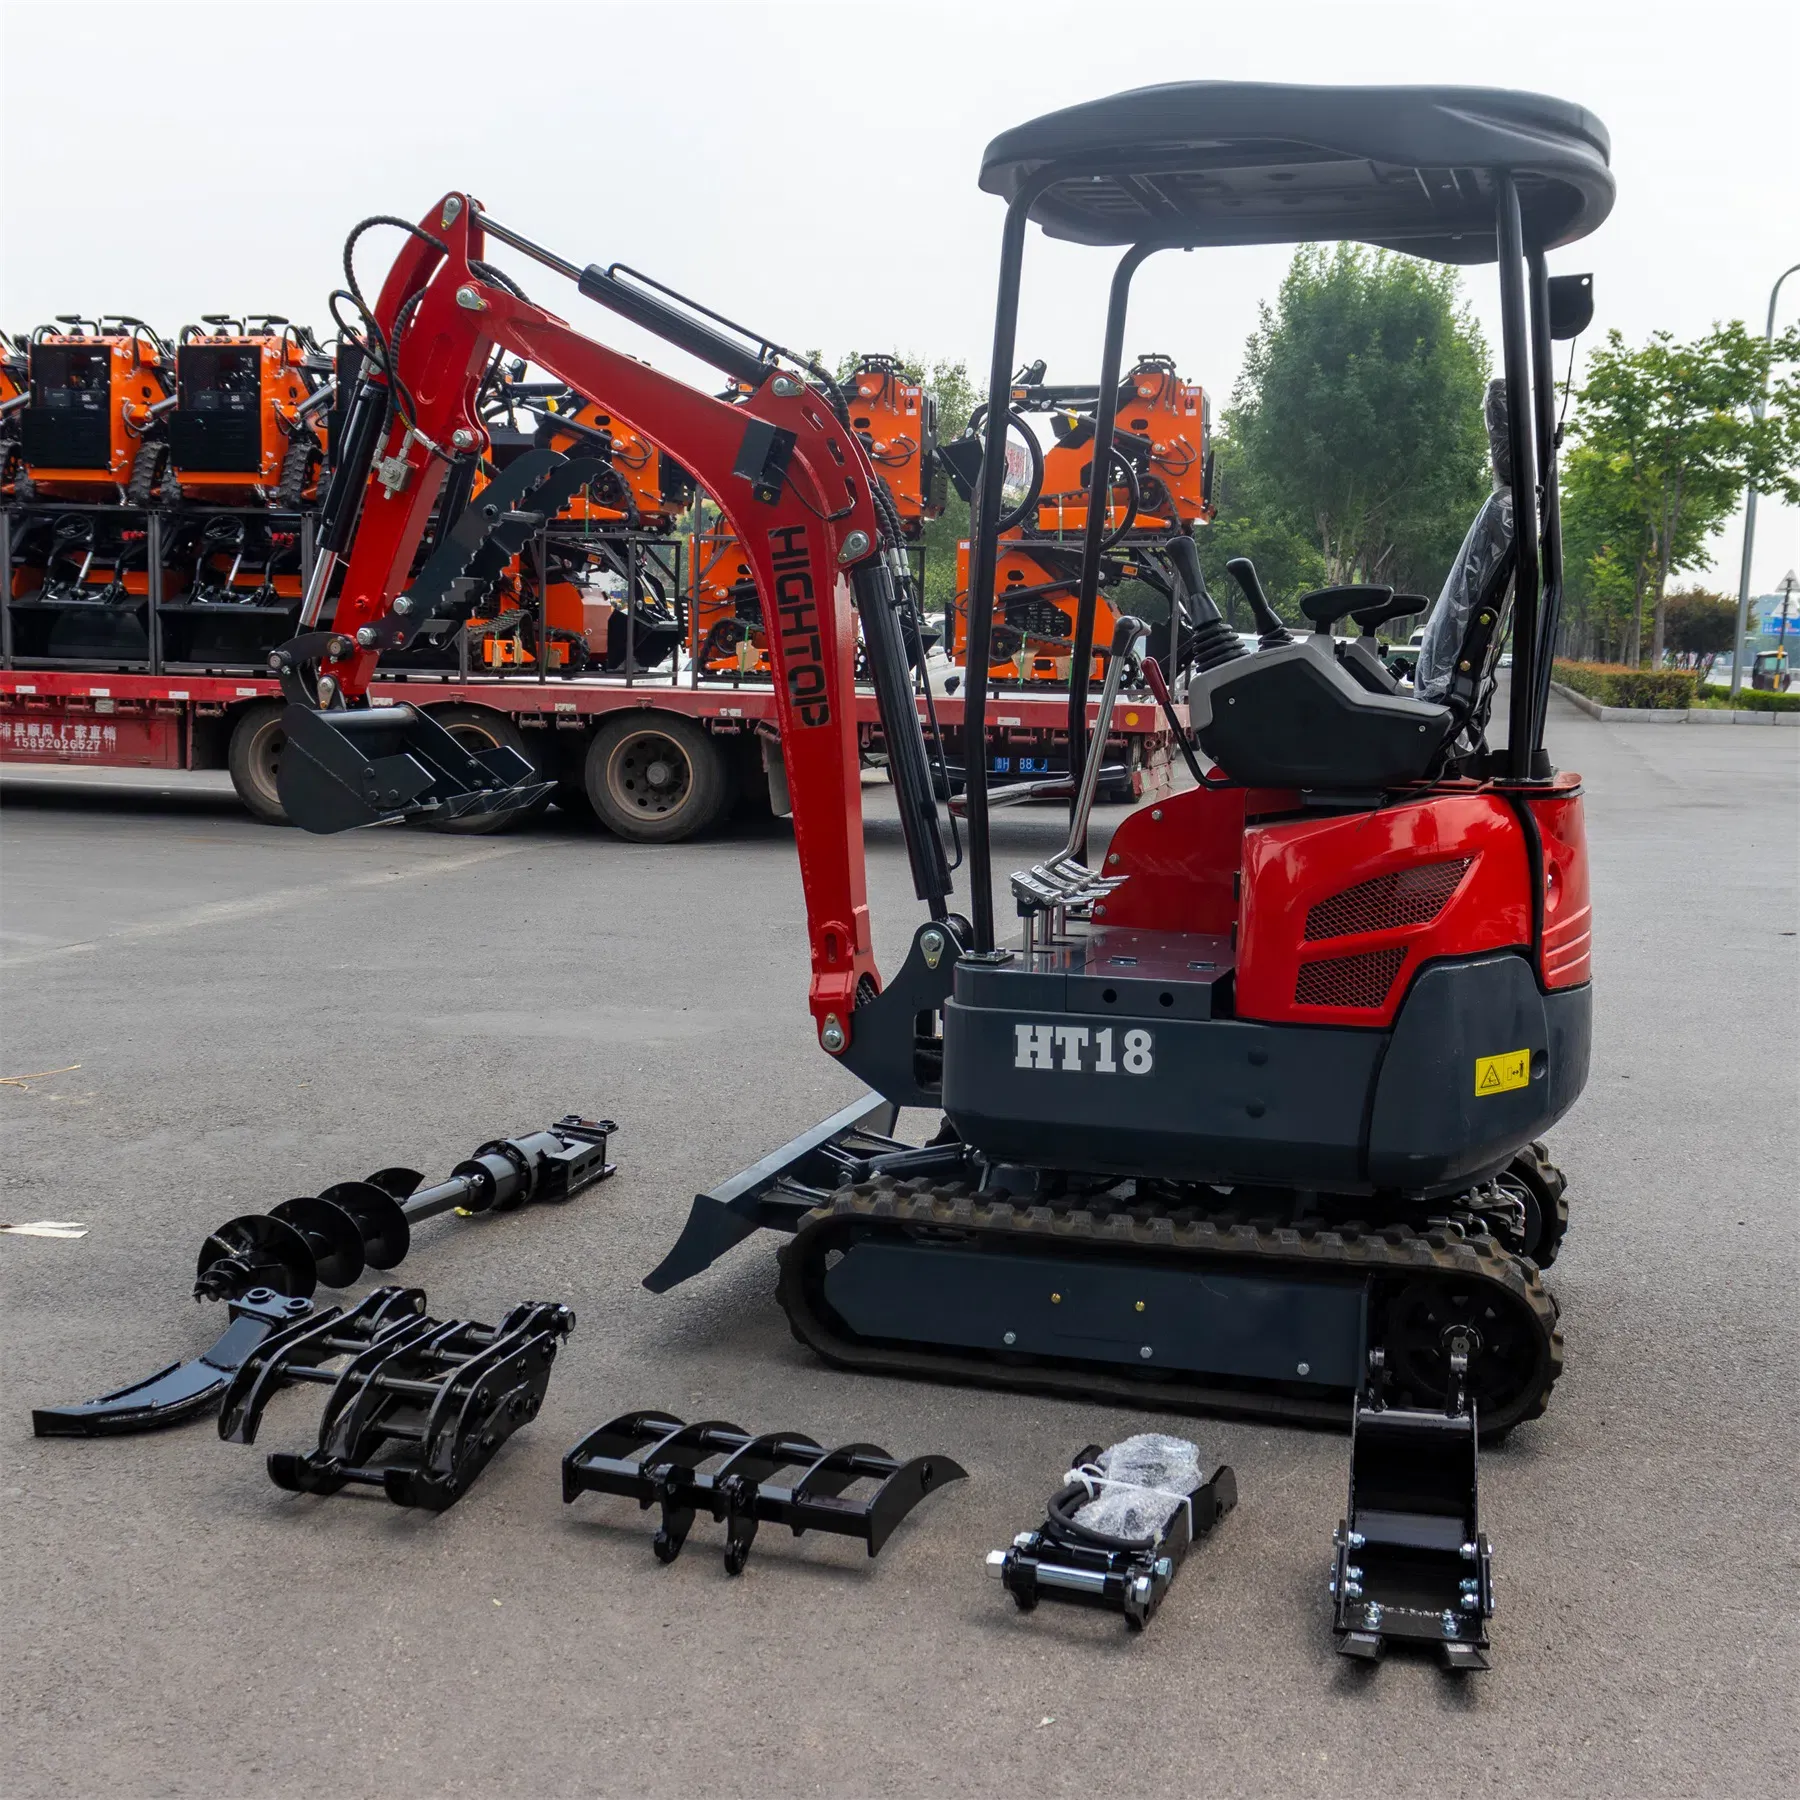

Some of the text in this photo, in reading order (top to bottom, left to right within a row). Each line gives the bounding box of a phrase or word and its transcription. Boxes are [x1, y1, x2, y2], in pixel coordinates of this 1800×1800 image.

[767, 525, 831, 727] HIGHTOP
[14, 737, 101, 751] 15852026527
[1015, 1024, 1153, 1074] HT18
